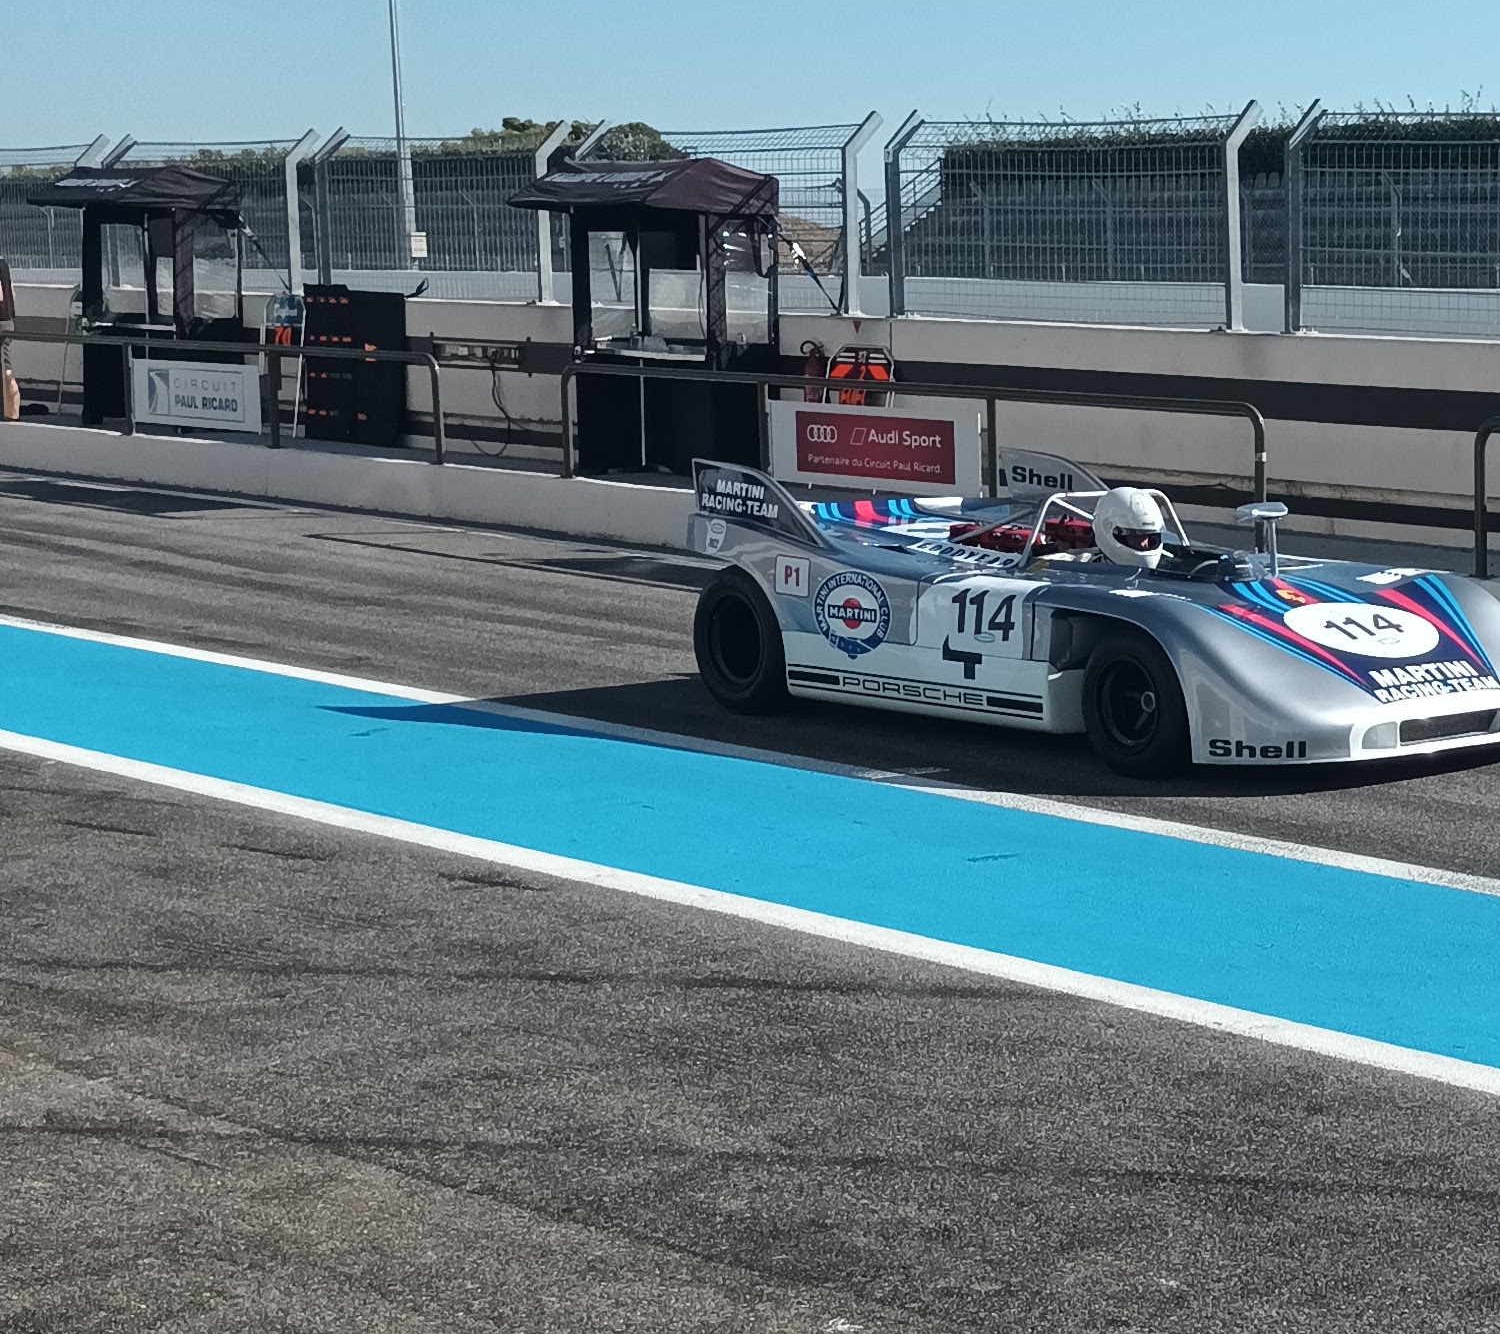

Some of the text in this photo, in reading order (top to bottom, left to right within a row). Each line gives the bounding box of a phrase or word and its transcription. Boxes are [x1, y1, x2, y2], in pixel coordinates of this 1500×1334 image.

[173, 377, 237, 393] CIRCUIT
[174, 394, 238, 413] PAUL RICARD
[867, 428, 942, 449] Audi Sport
[807, 453, 850, 467] Partenaire
[851, 458, 863, 468] du
[892, 460, 912, 472] Paul
[715, 479, 765, 500] MARTINI
[1011, 466, 1073, 491] Shell
[784, 564, 801, 588] P1
[816, 572, 889, 639] MARTINI INTERNATIONAL CLUB
[829, 606, 876, 621] MARTINI
[951, 588, 1018, 642] 114
[1323, 613, 1405, 640] 114
[1368, 660, 1480, 689] MARTINI
[842, 675, 984, 706] PORSCHE
[1208, 738, 1307, 759] Shell
